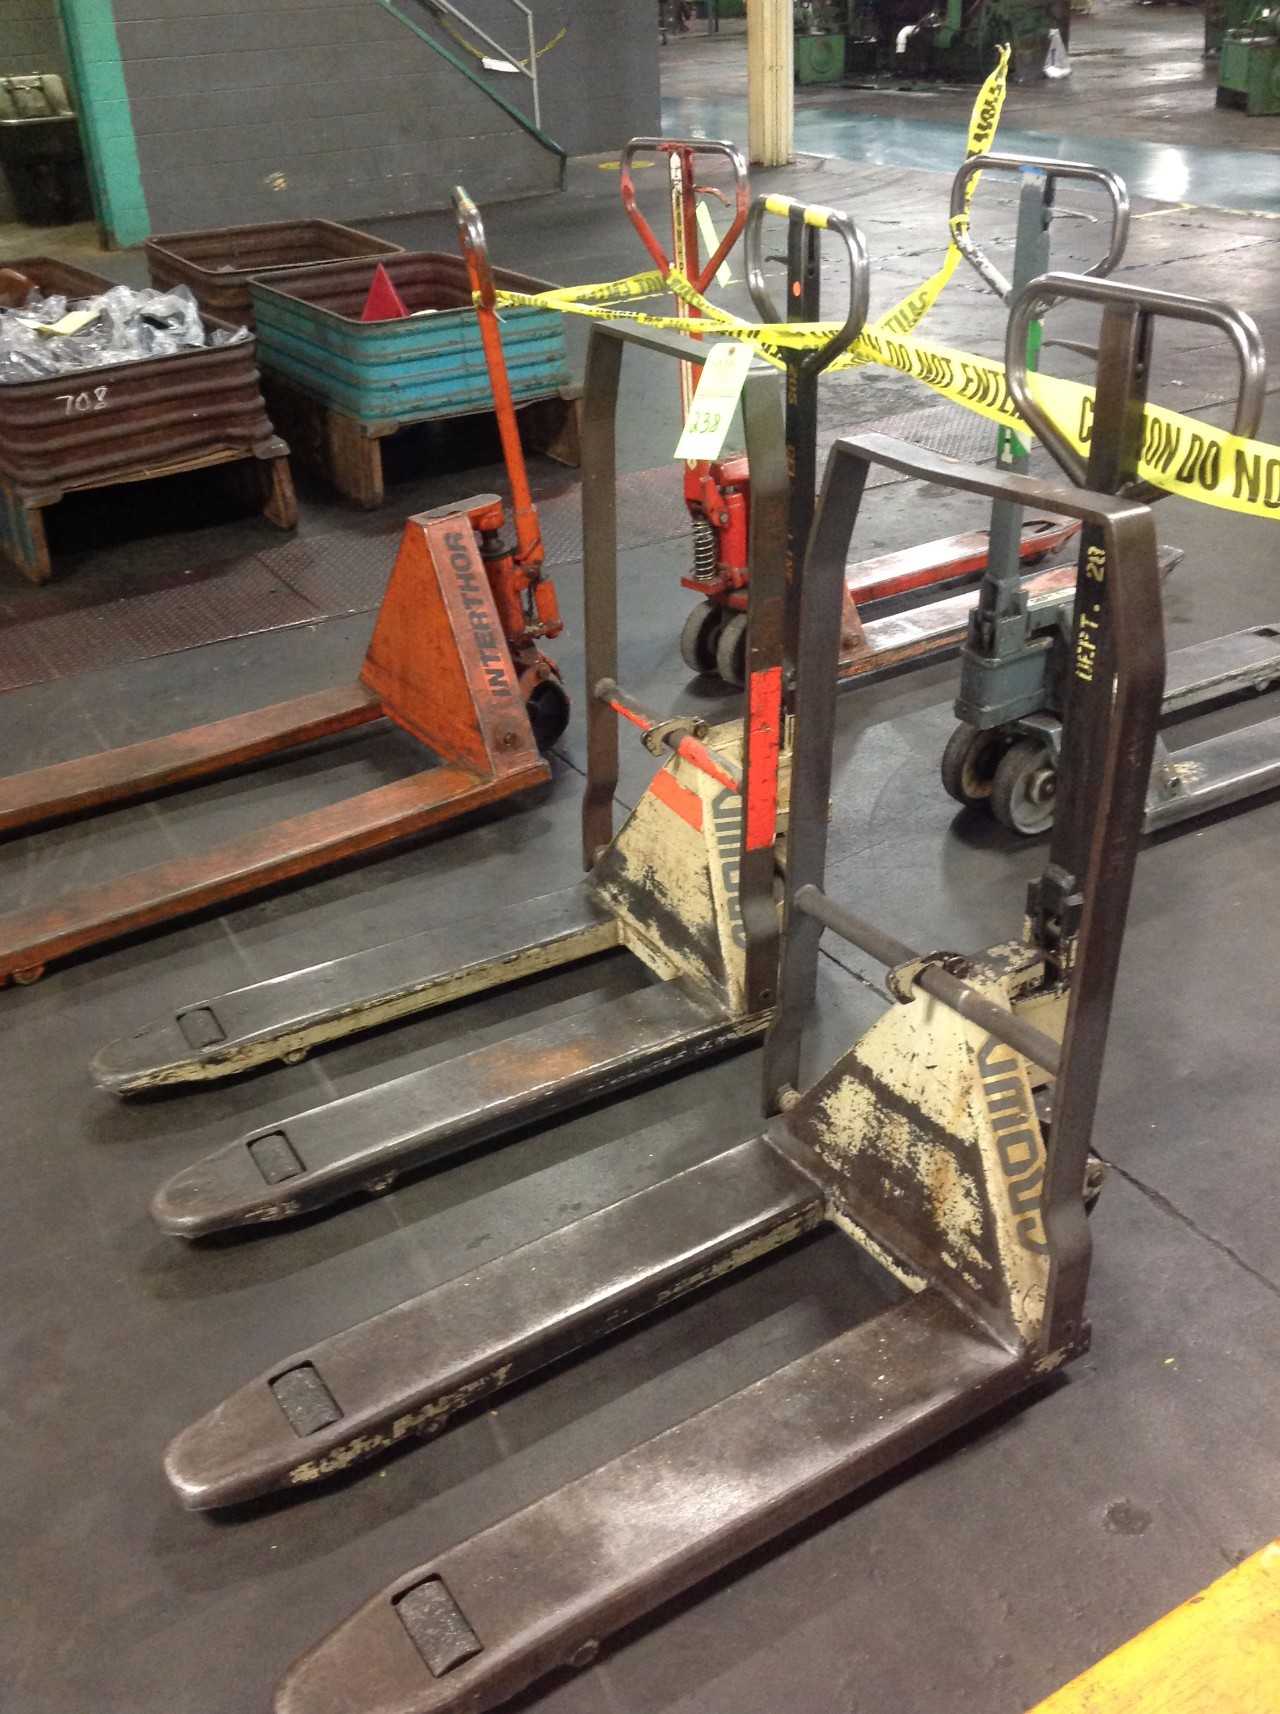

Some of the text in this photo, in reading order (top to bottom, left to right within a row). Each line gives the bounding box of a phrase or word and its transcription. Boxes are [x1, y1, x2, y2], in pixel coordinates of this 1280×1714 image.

[56, 385, 108, 415] 708
[886, 340, 912, 372] DO
[915, 349, 954, 388] NOT
[1176, 433, 1221, 490] DO
[1232, 449, 1280, 508] NO
[444, 532, 513, 697] INTERTHOR
